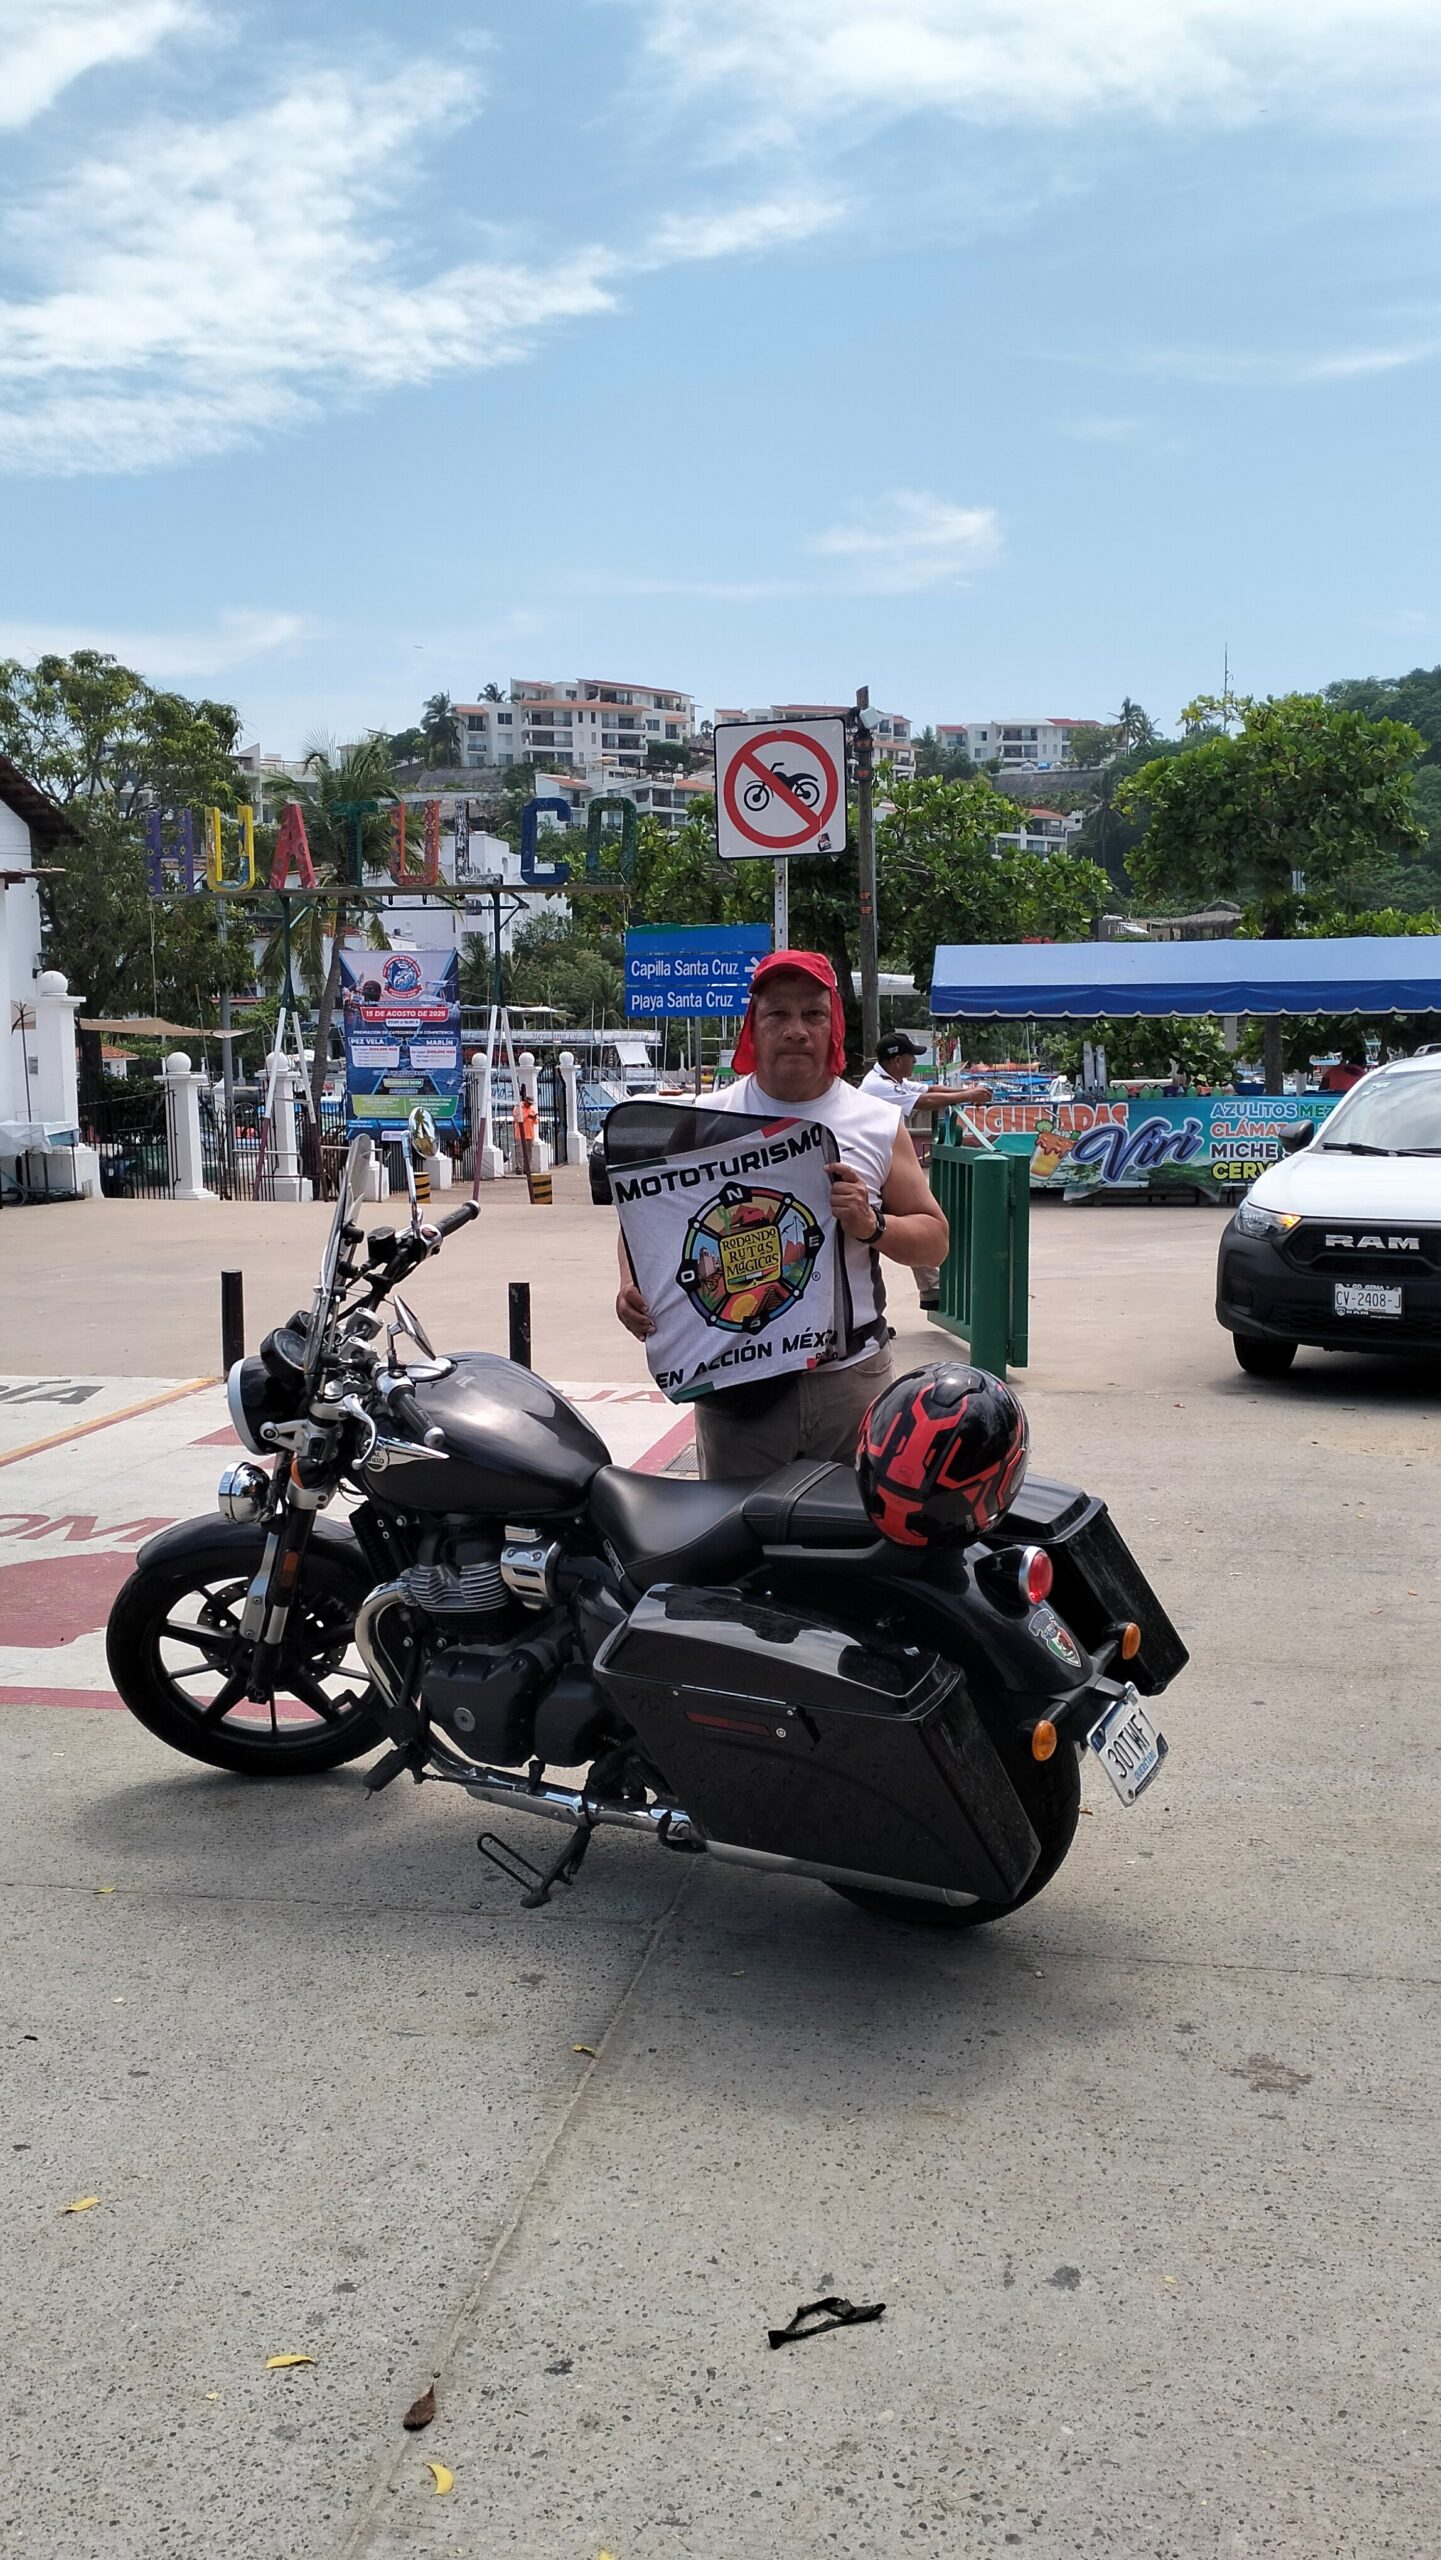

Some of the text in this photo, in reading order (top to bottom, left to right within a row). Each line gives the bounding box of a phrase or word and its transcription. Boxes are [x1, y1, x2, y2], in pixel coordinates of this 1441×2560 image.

[144, 797, 637, 895] HUATULCO
[631, 959, 739, 980] Capilla Santa Cruz
[631, 991, 734, 1012] Playa Santa Cruz
[386, 1010, 416, 1018] AGOSTO
[417, 1010, 428, 1018] DE
[426, 1038, 454, 1046] MARLÍN
[1211, 1102, 1297, 1118] AZULITOS
[1071, 1116, 1203, 1183] Viri
[615, 1123, 823, 1205] MOTOTURISMO
[726, 1187, 744, 1201] N
[808, 1234, 820, 1248] E
[1325, 1234, 1420, 1250] RAM
[1336, 1291, 1402, 1309] CV-2408-J
[656, 1368, 684, 1389] EN
[692, 1339, 773, 1377] ACCIÓN
